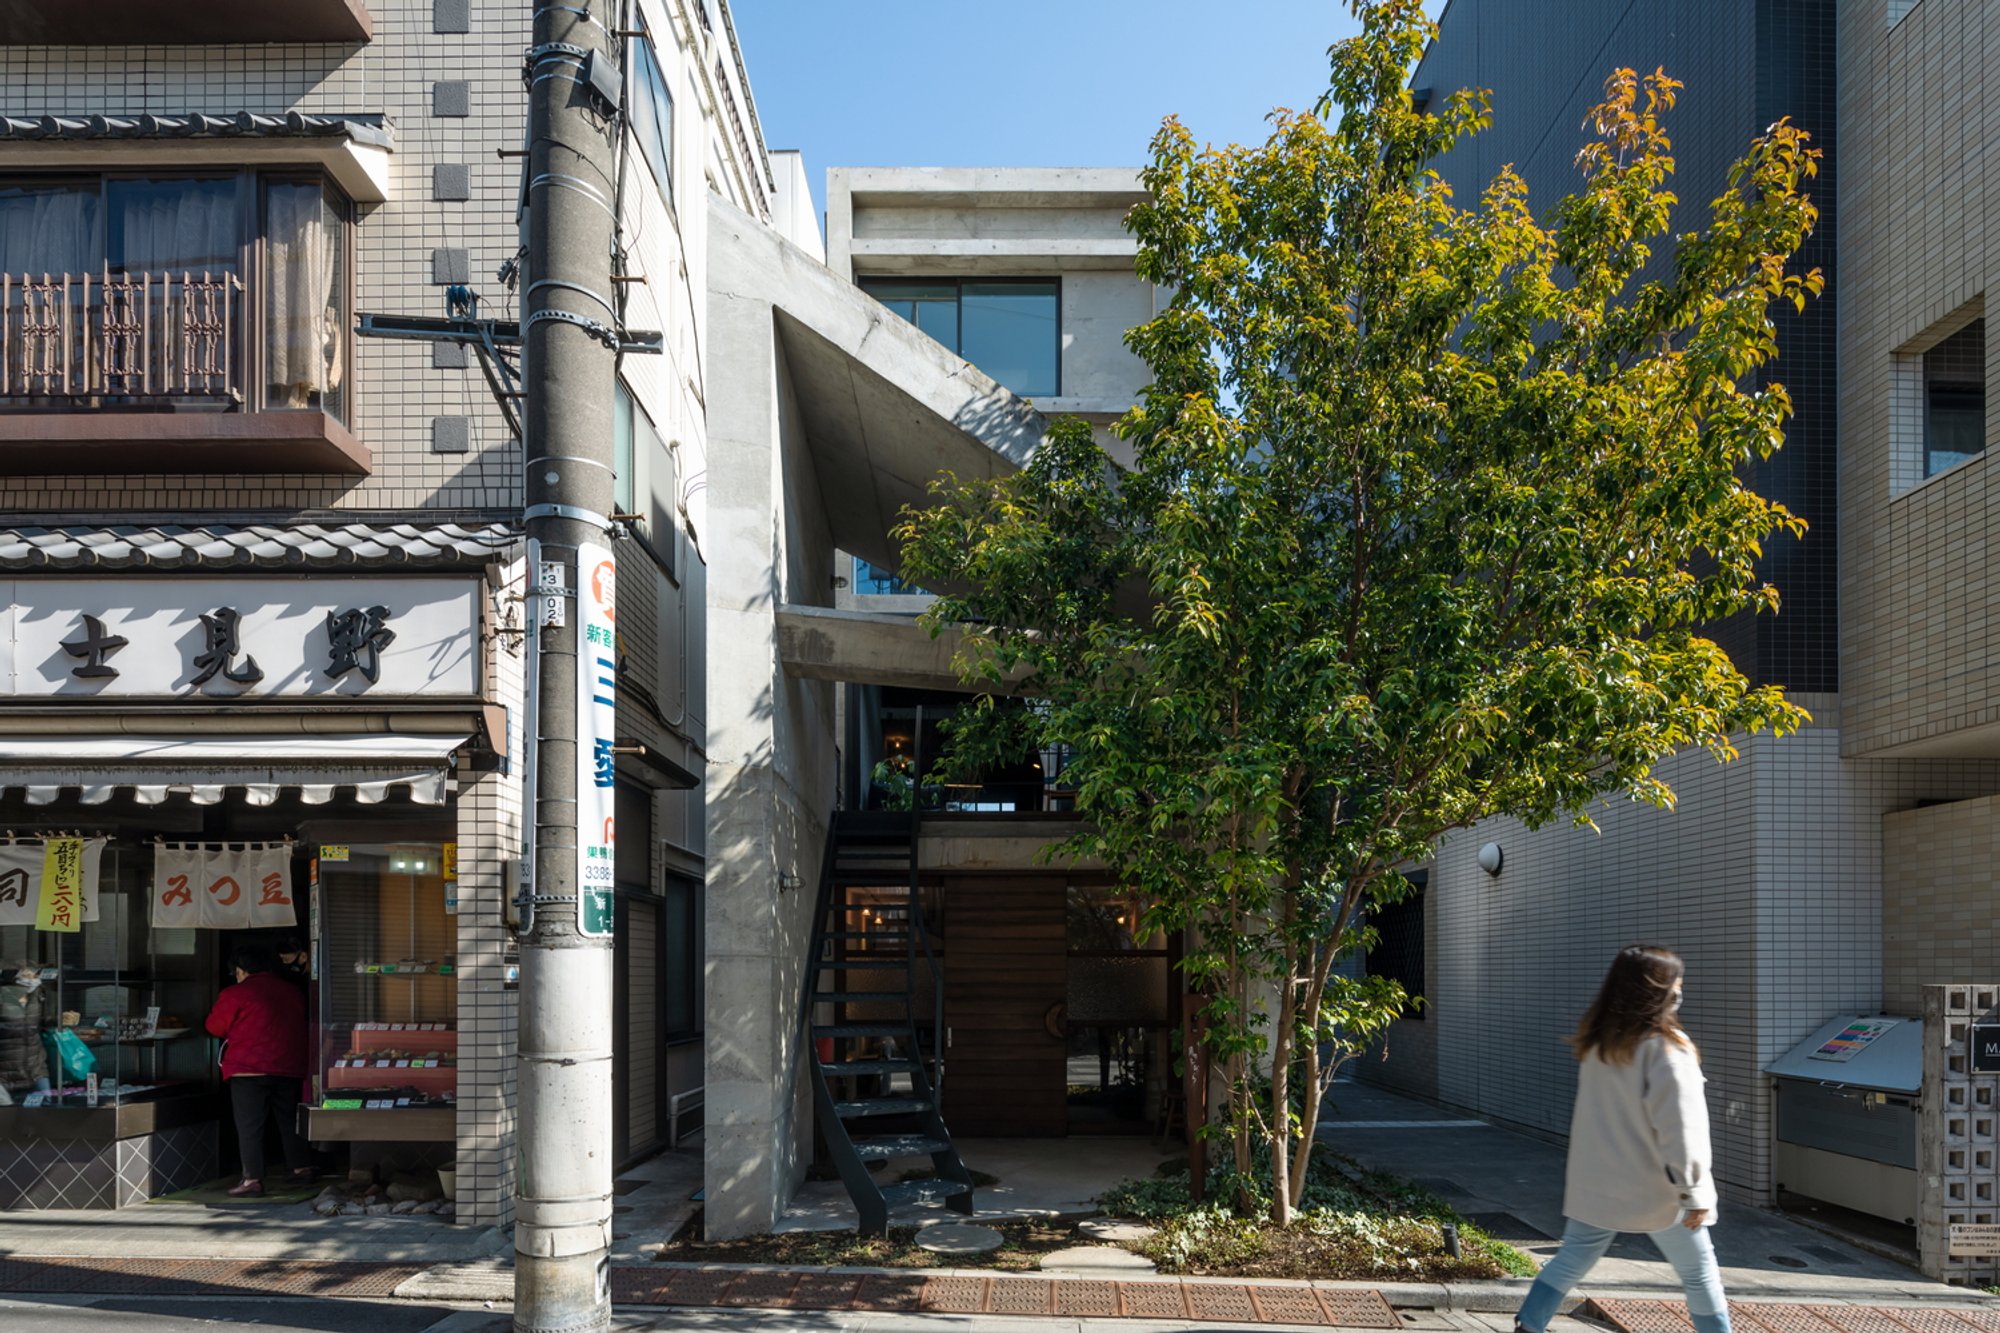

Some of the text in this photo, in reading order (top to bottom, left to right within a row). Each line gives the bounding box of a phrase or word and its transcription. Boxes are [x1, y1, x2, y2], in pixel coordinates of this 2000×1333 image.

[59, 605, 396, 686] 士見野
[161, 872, 291, 906] みつ豆
[1985, 1042, 2000, 1054] M
